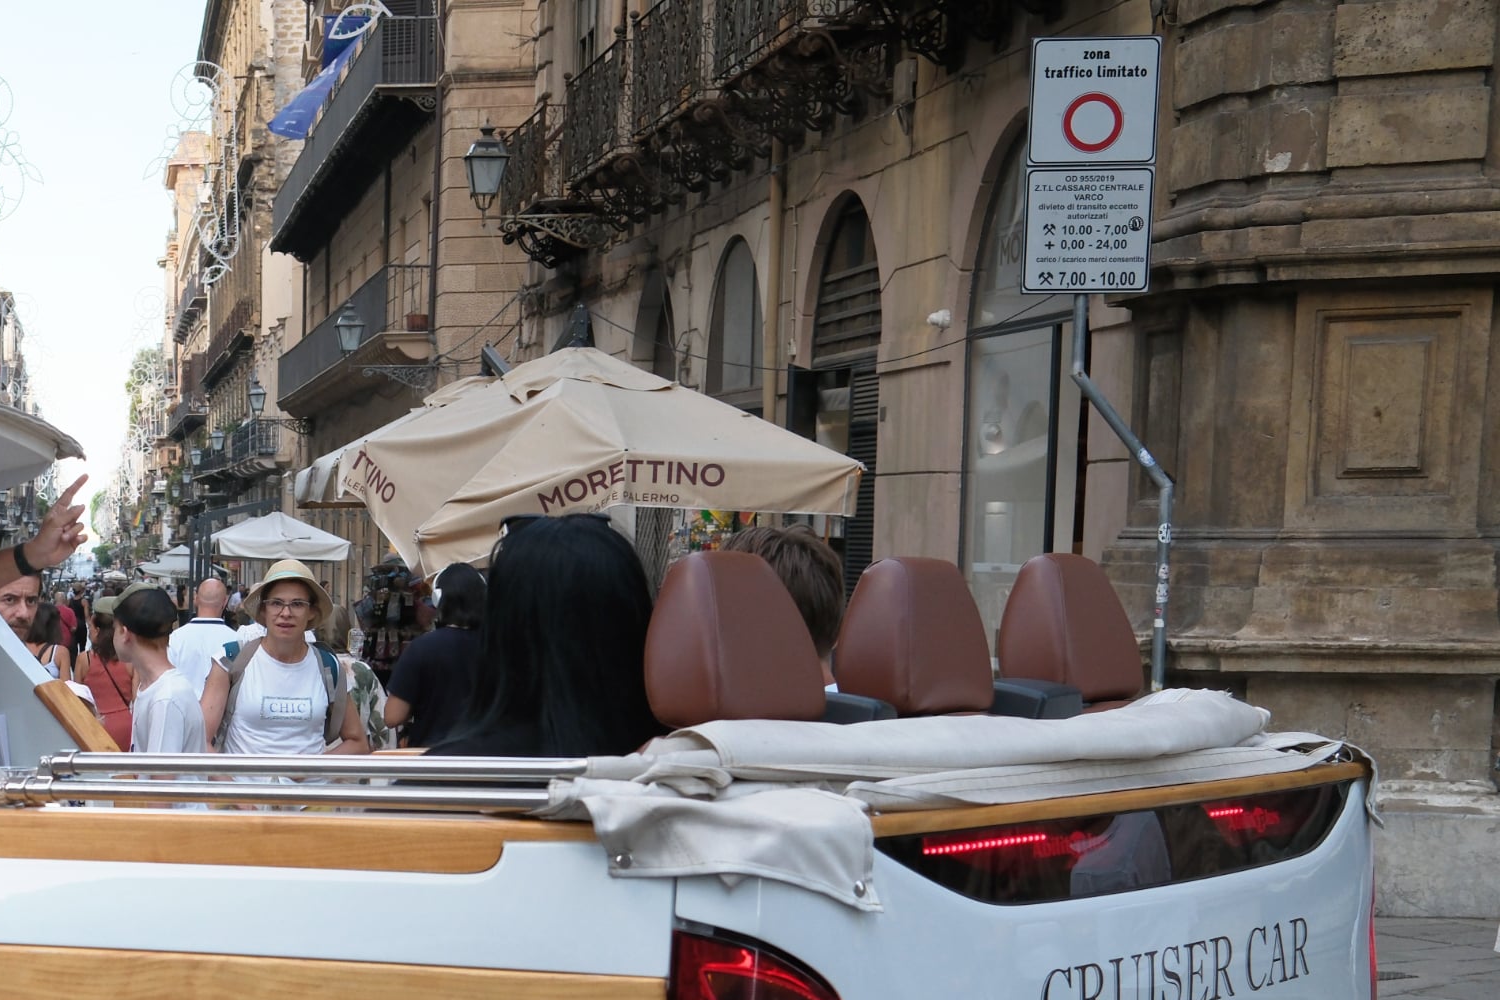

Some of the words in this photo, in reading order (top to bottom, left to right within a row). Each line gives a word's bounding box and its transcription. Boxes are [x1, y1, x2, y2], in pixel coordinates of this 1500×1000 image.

[1083, 51, 1110, 60] zona
[1044, 66, 1093, 79] traffico
[1097, 66, 1148, 78] limitato
[1055, 184, 1097, 192] CASSARO
[1074, 193, 1104, 201] VARCO
[1067, 212, 1108, 220] autorizzati
[1061, 225, 1093, 235] 10.00
[1104, 224, 1128, 236] 7,00
[1060, 239, 1085, 251] 0,00
[1096, 239, 1127, 250] 24,00
[1088, 255, 1108, 263] merci
[1058, 271, 1086, 288] 7,00
[1100, 271, 1136, 288] 10,00
[537, 459, 725, 514] MORETTINO
[623, 490, 680, 503] PALERMO
[269, 702, 306, 713] CHIC
[1245, 917, 1310, 991] CAR
